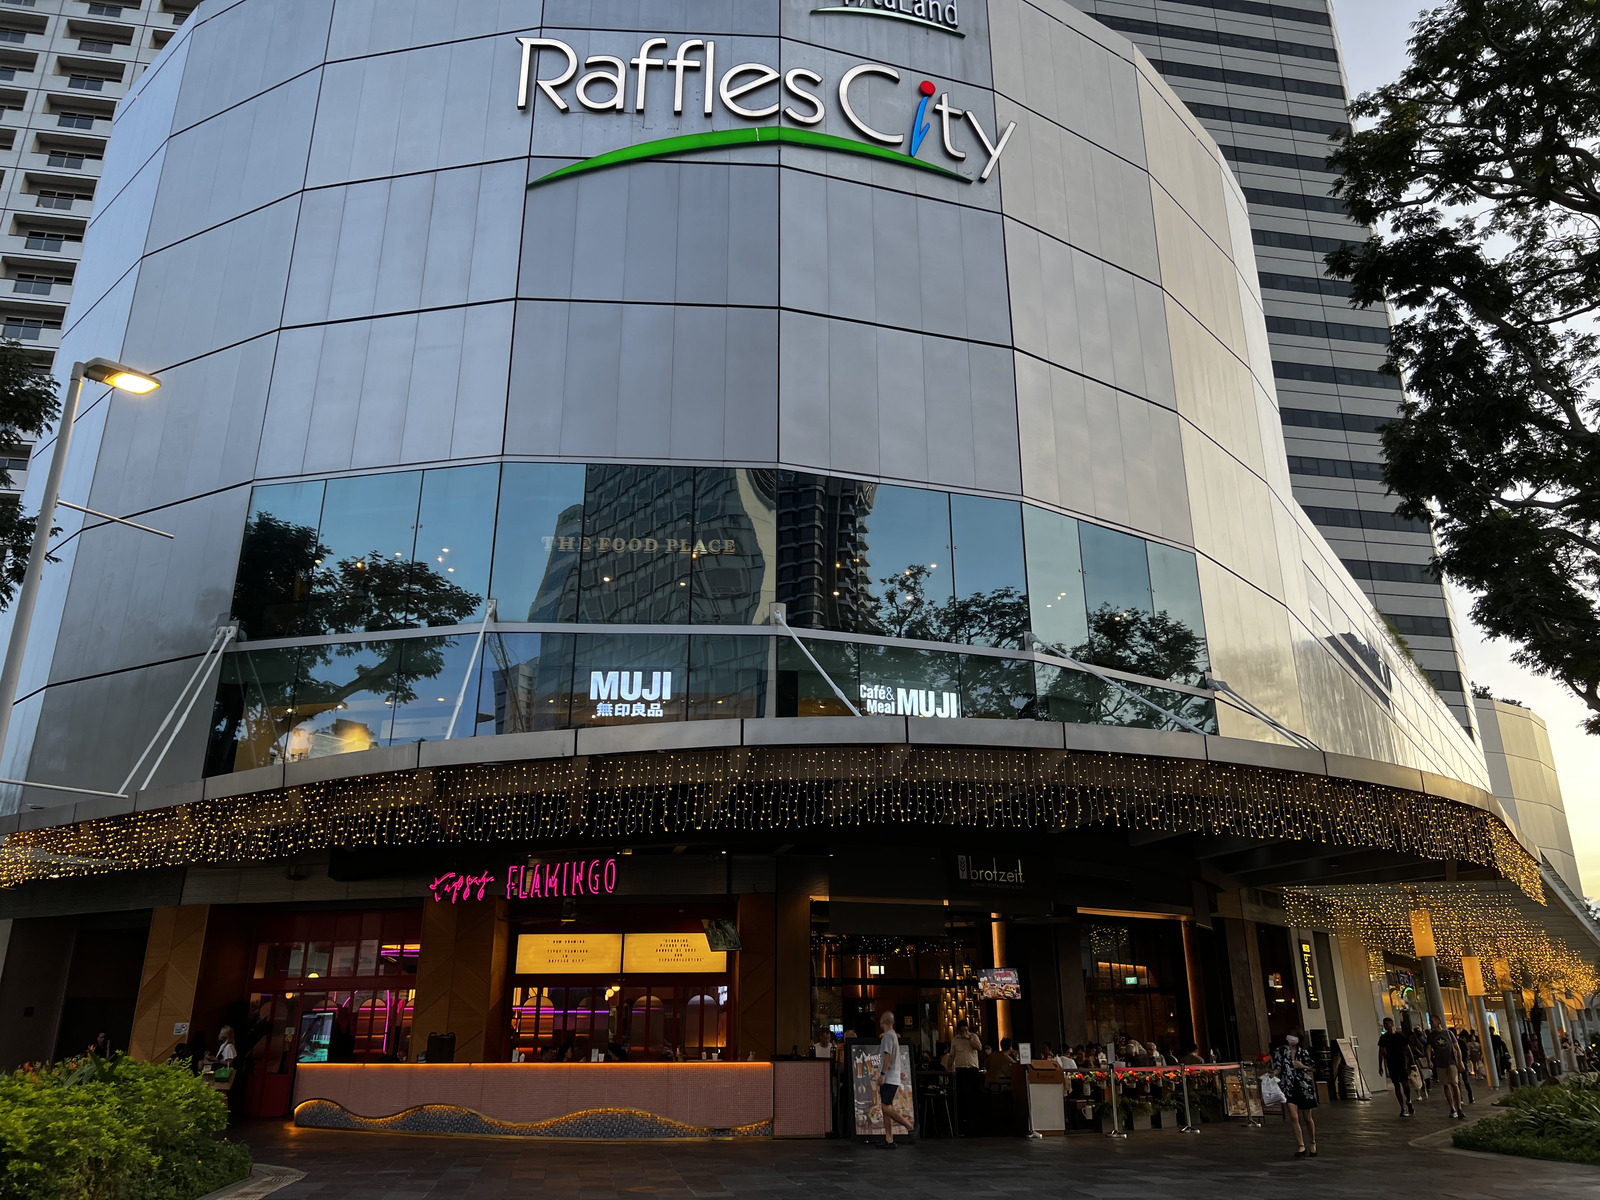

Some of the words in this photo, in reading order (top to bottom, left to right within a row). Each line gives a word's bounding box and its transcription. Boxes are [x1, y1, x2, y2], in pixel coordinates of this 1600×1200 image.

[516, 37, 826, 125] Raffles
[838, 63, 1018, 183] City
[541, 536, 592, 553] THE
[598, 538, 658, 553] FOOD
[666, 538, 735, 555] PLACE
[589, 671, 672, 701] MUJI
[596, 702, 664, 718] 無印良品
[866, 699, 896, 715] Meal
[896, 687, 958, 718] MUJI
[506, 858, 616, 900] FLAMINGO
[1303, 953, 1318, 1002] brotzeit
